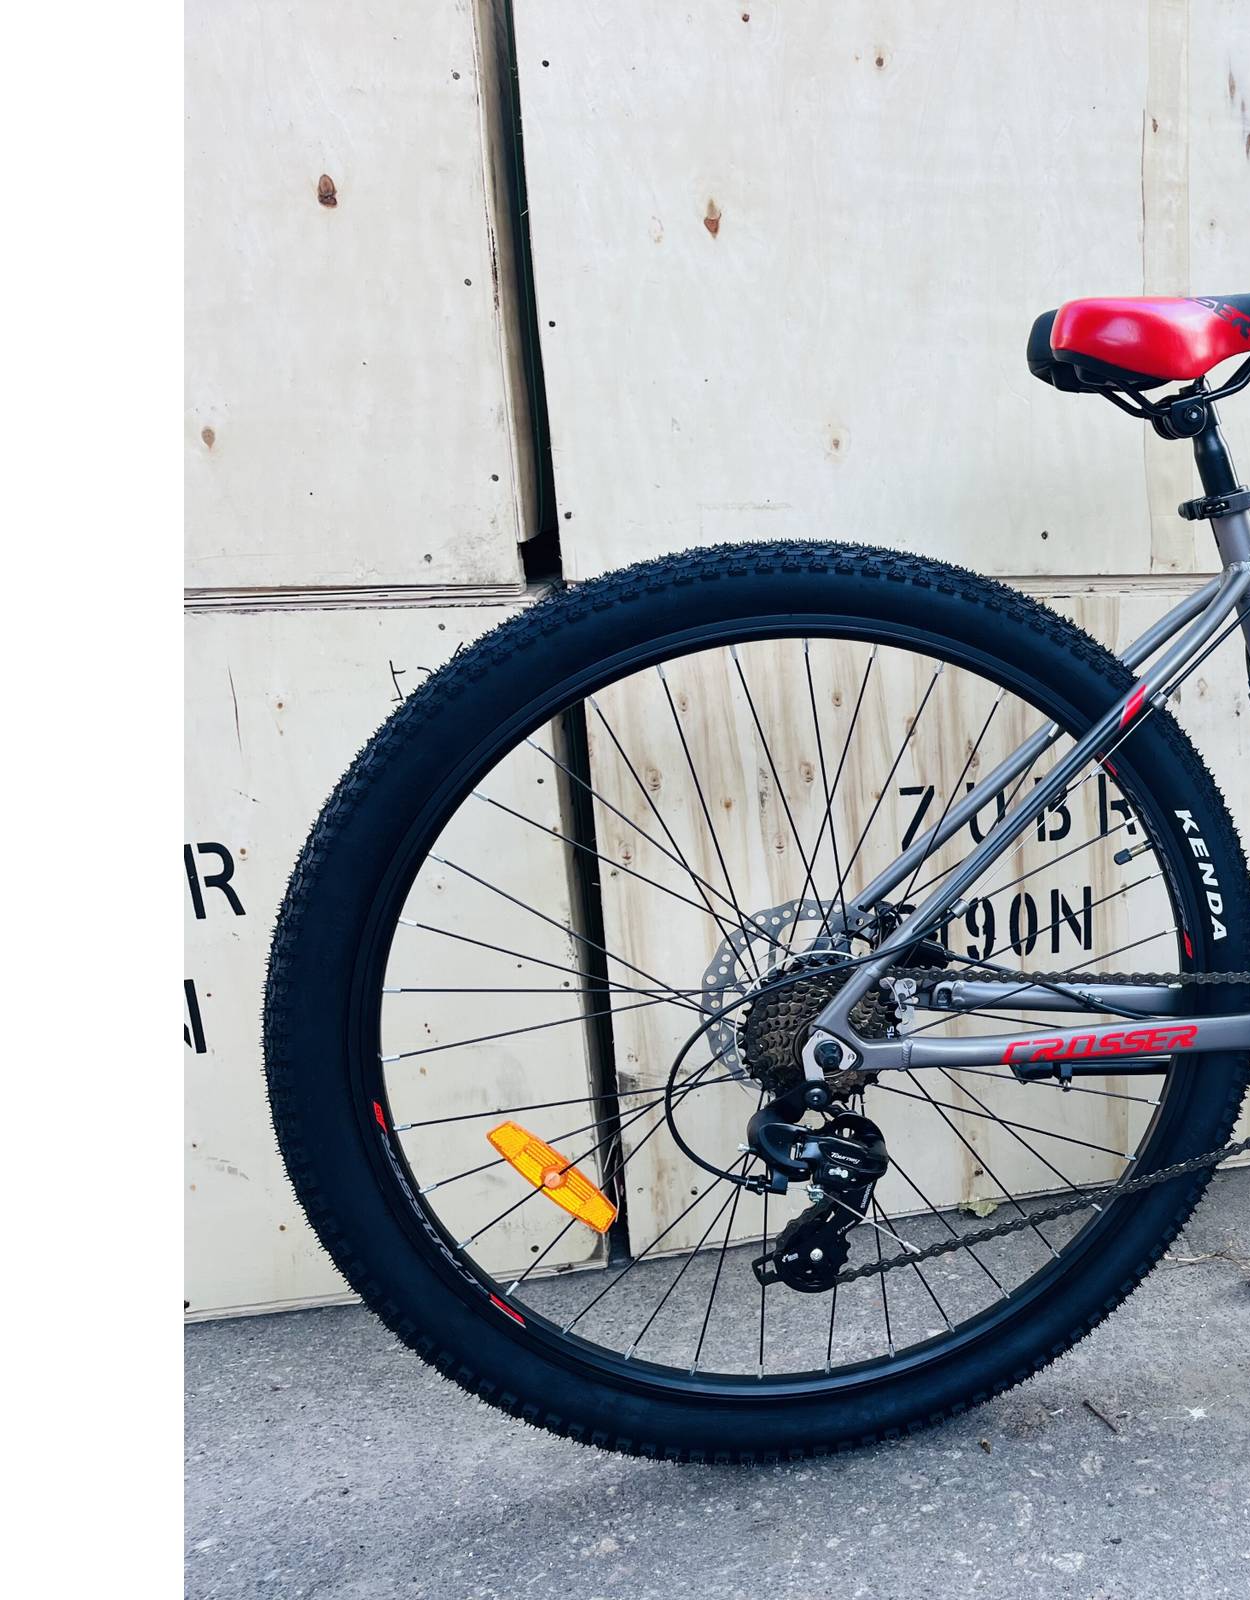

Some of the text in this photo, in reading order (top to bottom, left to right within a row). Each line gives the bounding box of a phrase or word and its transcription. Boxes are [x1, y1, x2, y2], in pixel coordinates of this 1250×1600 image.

[1174, 809, 1228, 941] KENDA
[1001, 1025, 1199, 1065] CROSSER
[381, 1132, 480, 1286] CROSSER
